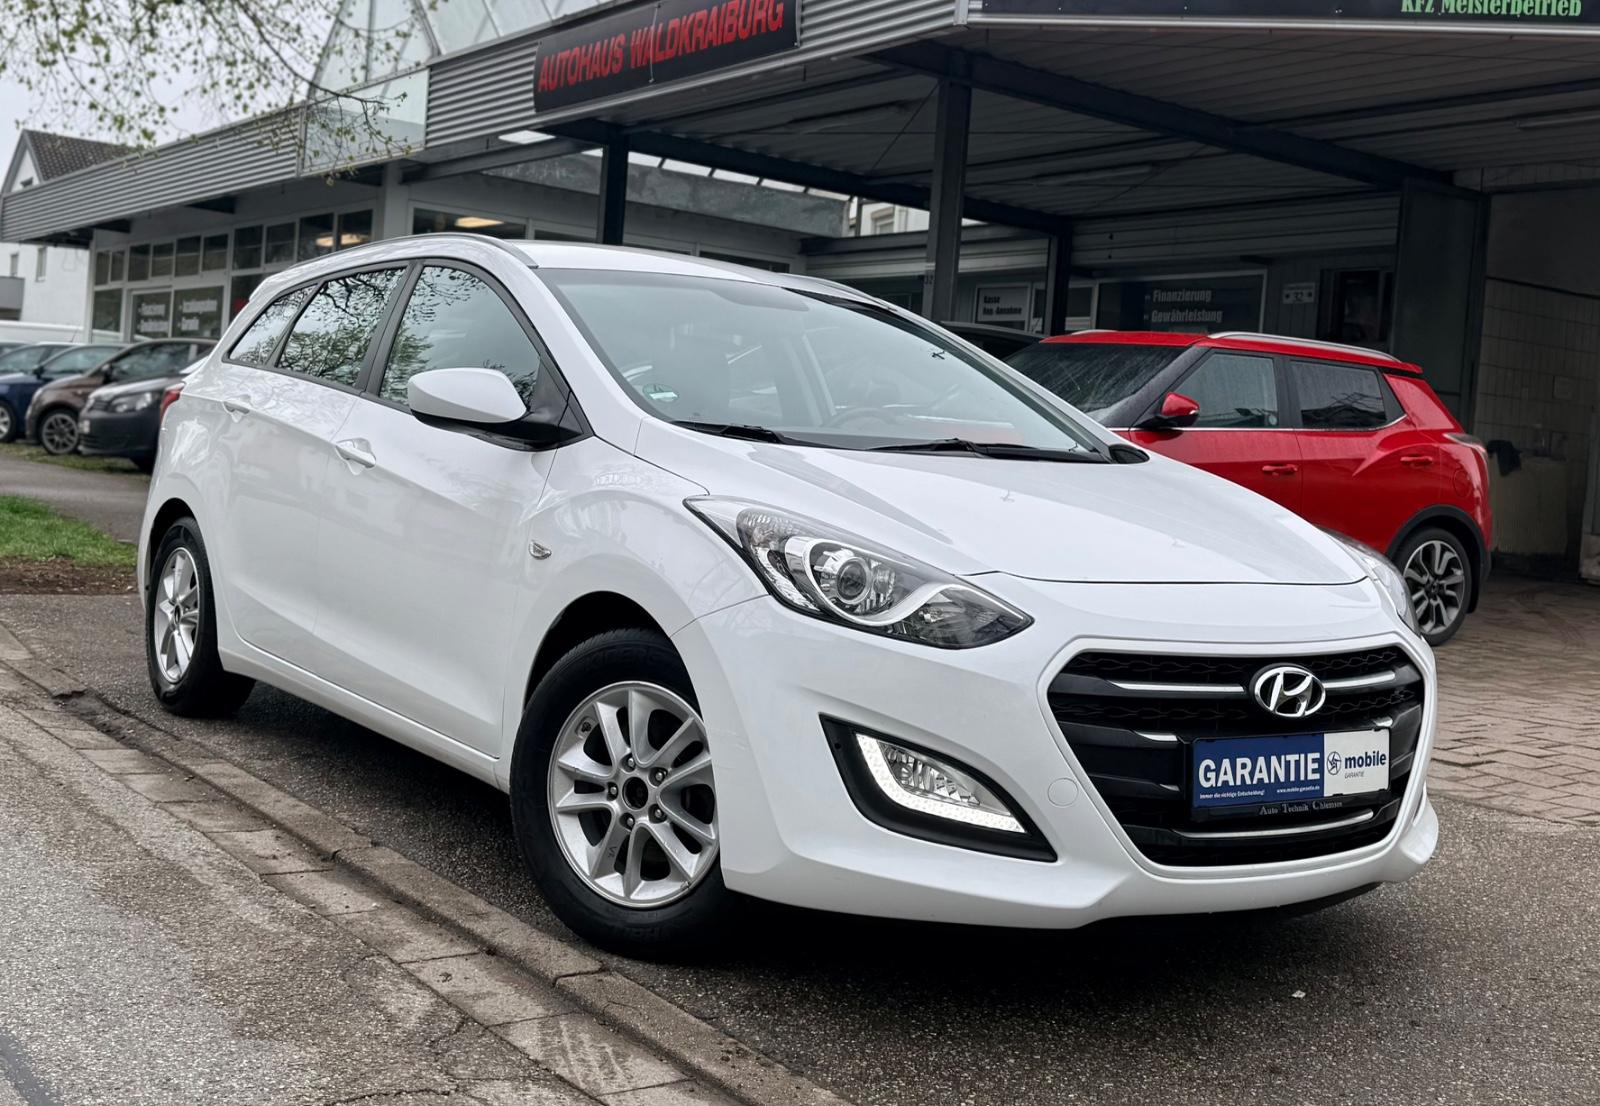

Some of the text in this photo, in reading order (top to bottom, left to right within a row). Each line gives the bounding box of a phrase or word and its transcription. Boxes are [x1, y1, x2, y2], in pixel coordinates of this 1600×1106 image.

[1400, 0, 1434, 13] KFZ
[537, 0, 785, 92] AUTOHAUS WALDKRAIBURG
[1153, 288, 1212, 303] Finanzierung
[1151, 309, 1223, 323] Gewährleistung
[1344, 750, 1387, 769] mobile
[1199, 752, 1321, 788] GARANTIE
[1259, 806, 1279, 815] Auto
[1281, 803, 1309, 813] Technik
